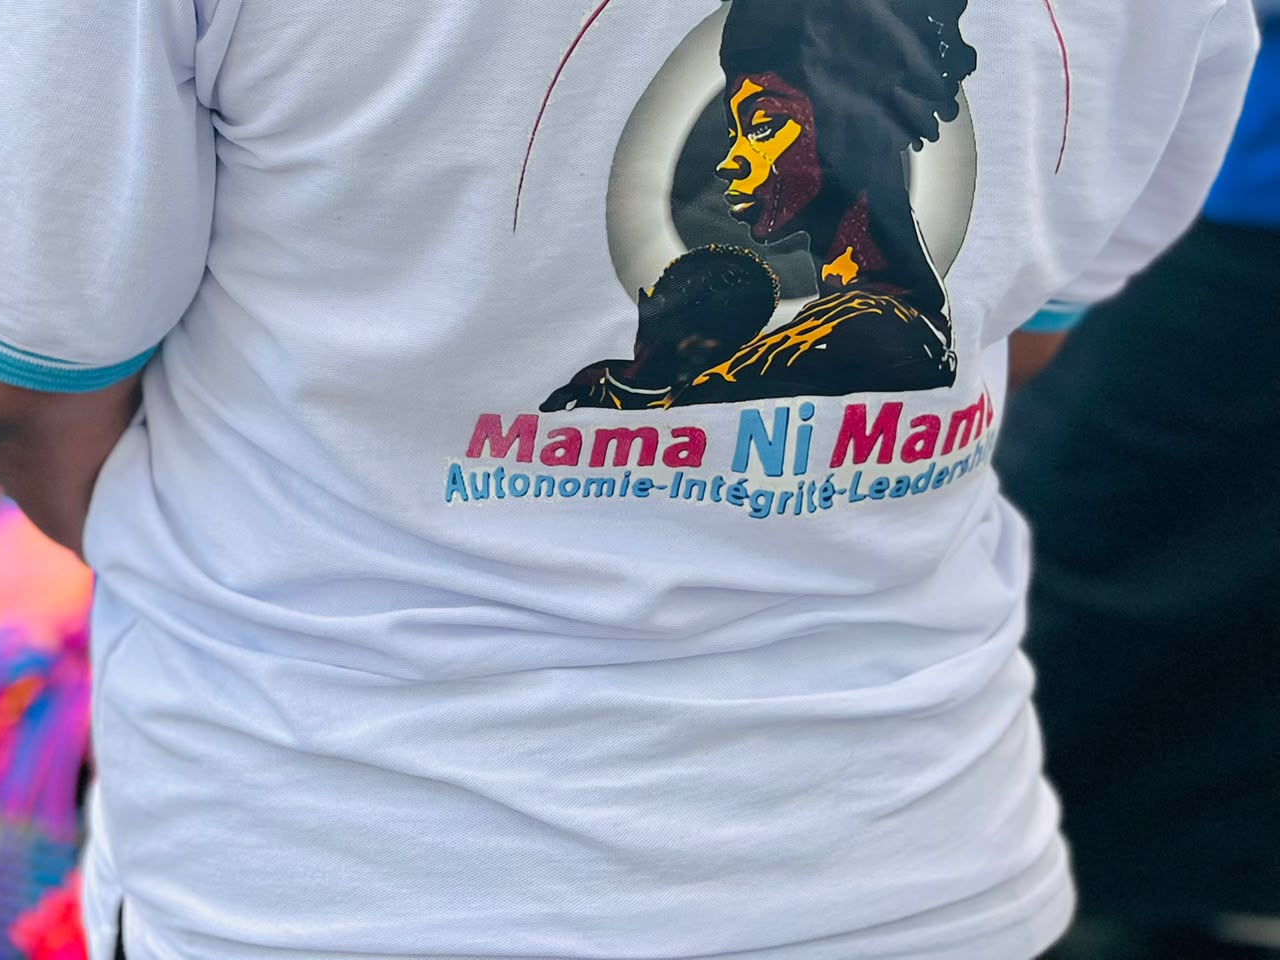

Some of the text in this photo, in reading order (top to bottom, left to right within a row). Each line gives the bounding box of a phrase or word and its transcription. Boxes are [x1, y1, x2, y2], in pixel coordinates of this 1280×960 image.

[445, 430, 995, 518] Autonomie-Intégrité-Leadersh
[465, 413, 707, 468] Mama
[731, 406, 813, 477] Ni
